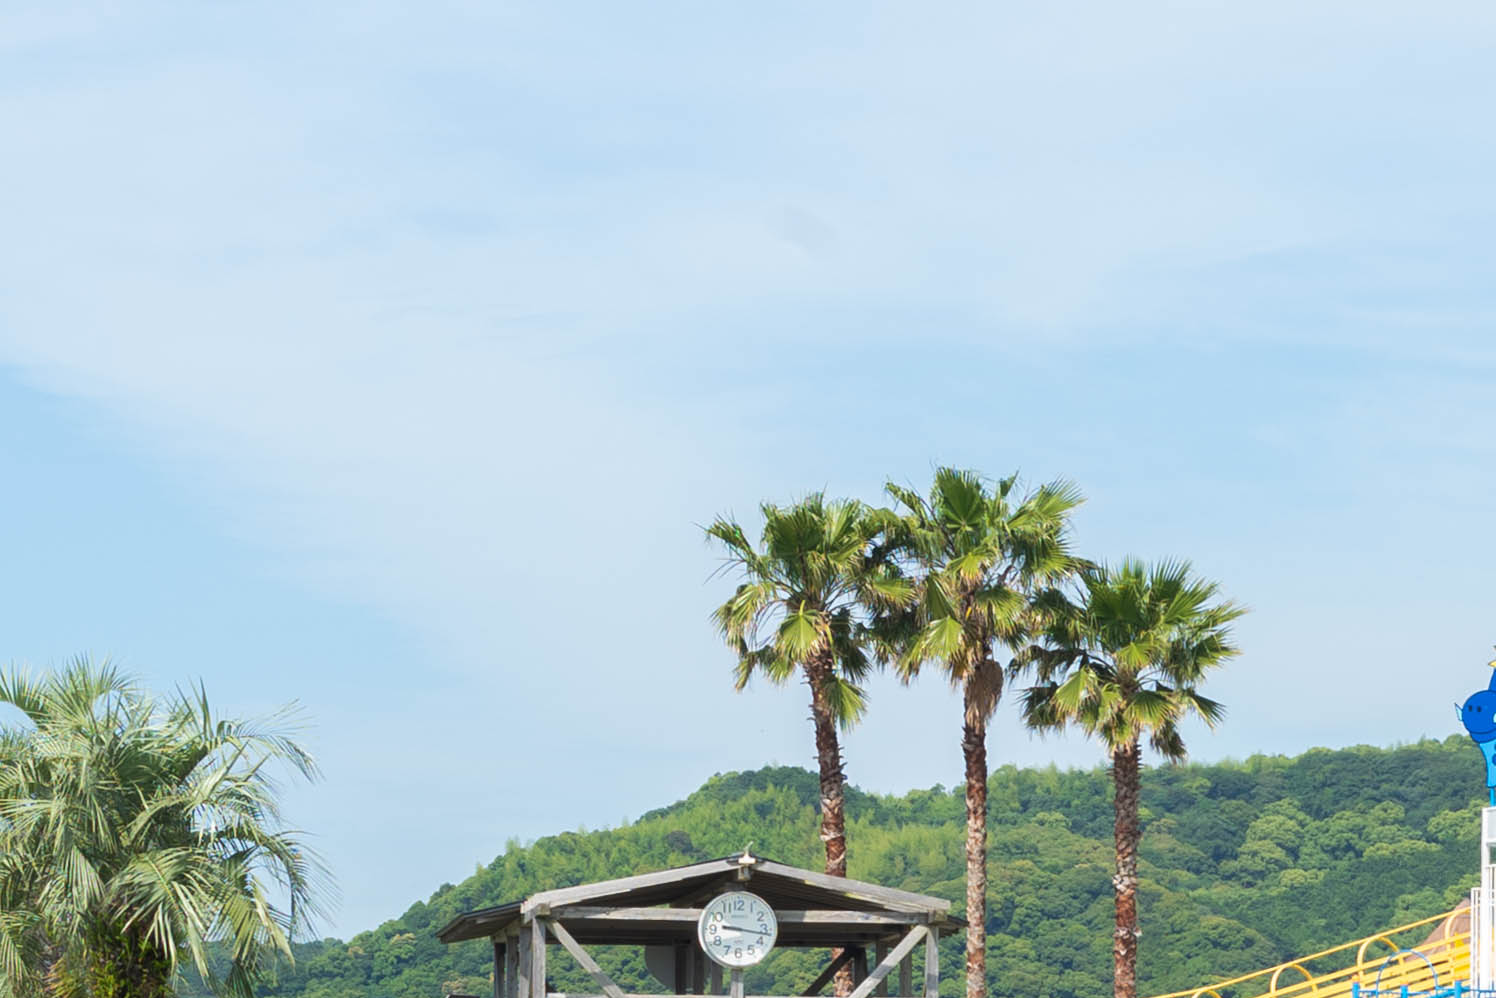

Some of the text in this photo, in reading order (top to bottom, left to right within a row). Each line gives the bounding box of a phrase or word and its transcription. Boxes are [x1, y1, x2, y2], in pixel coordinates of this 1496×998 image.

[721, 900, 732, 913] 11
[734, 900, 745, 911] 12
[710, 912, 723, 922] 10
[757, 911, 764, 921] 2
[709, 924, 717, 935] 9
[760, 924, 768, 935] 3
[713, 935, 722, 946] 8
[756, 936, 764, 946] 4
[723, 944, 732, 955] 7
[734, 948, 743, 959] 6
[747, 944, 755, 955] 5
